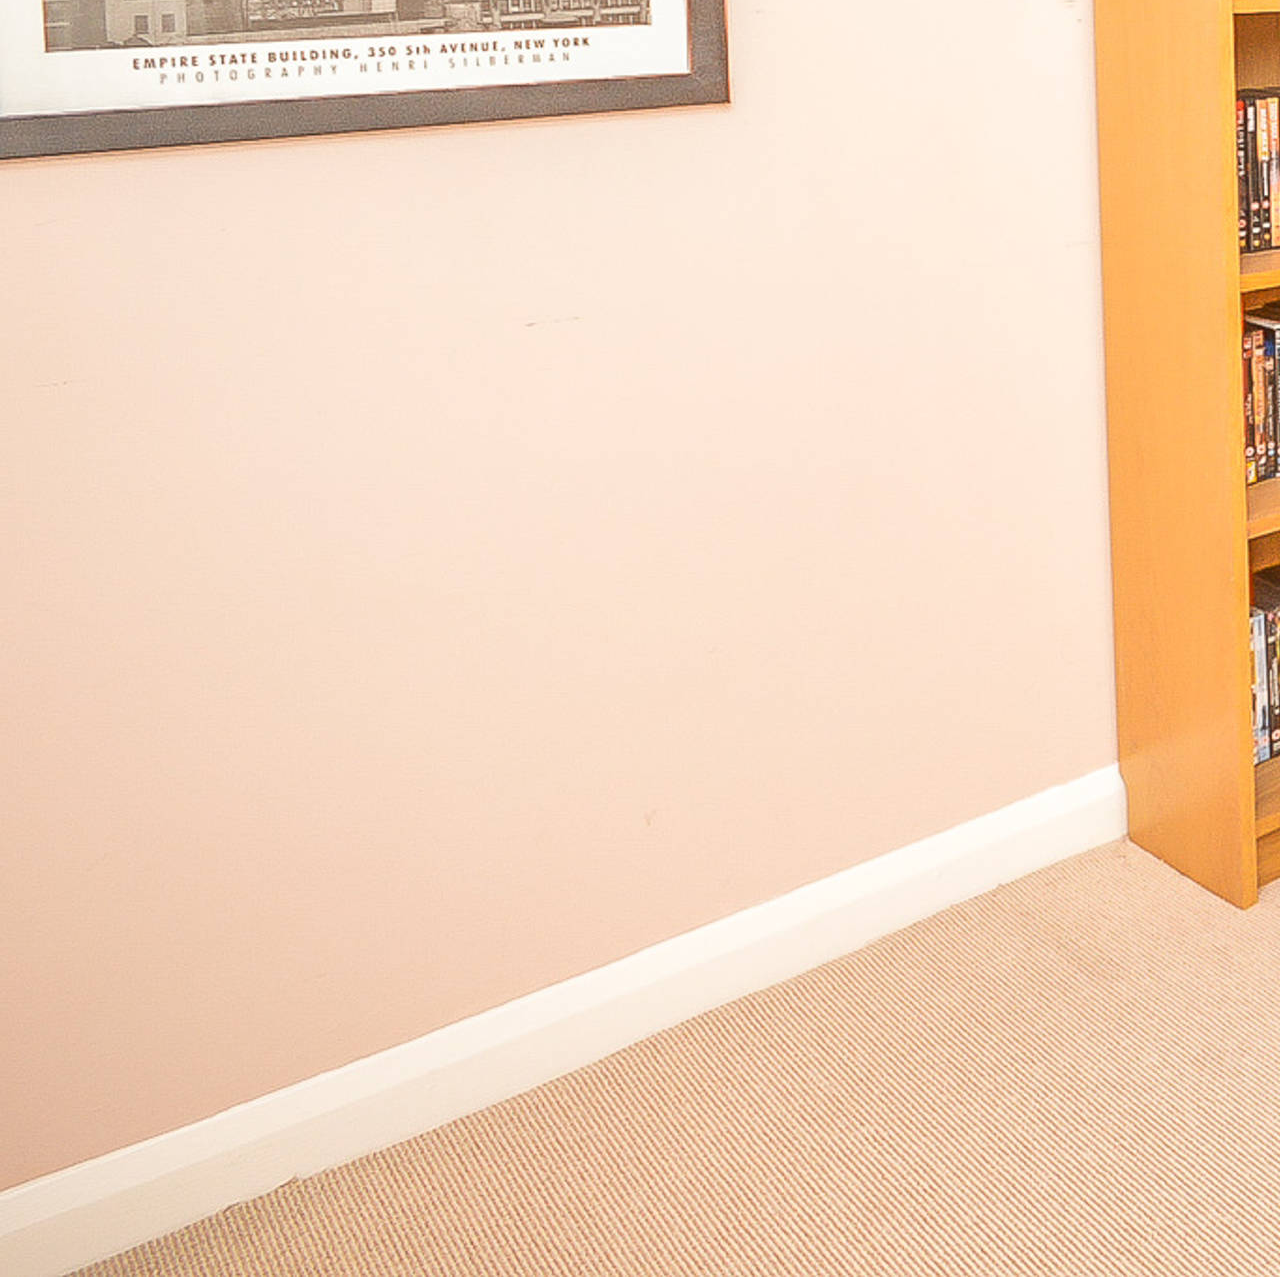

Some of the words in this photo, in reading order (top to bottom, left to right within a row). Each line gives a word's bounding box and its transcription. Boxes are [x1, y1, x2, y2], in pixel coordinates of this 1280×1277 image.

[132, 55, 200, 70] EMPIRE
[209, 52, 258, 66] STATE
[267, 47, 359, 63] BUILDING,
[367, 46, 397, 58] 350
[405, 44, 431, 56] 5th
[440, 40, 506, 54] AVENUE,
[513, 39, 546, 50] NEW
[552, 37, 590, 48] YORK
[159, 66, 338, 85] PHOTOGRAPHY
[359, 59, 429, 73] HENRI
[448, 52, 571, 69] SILBERMAN
